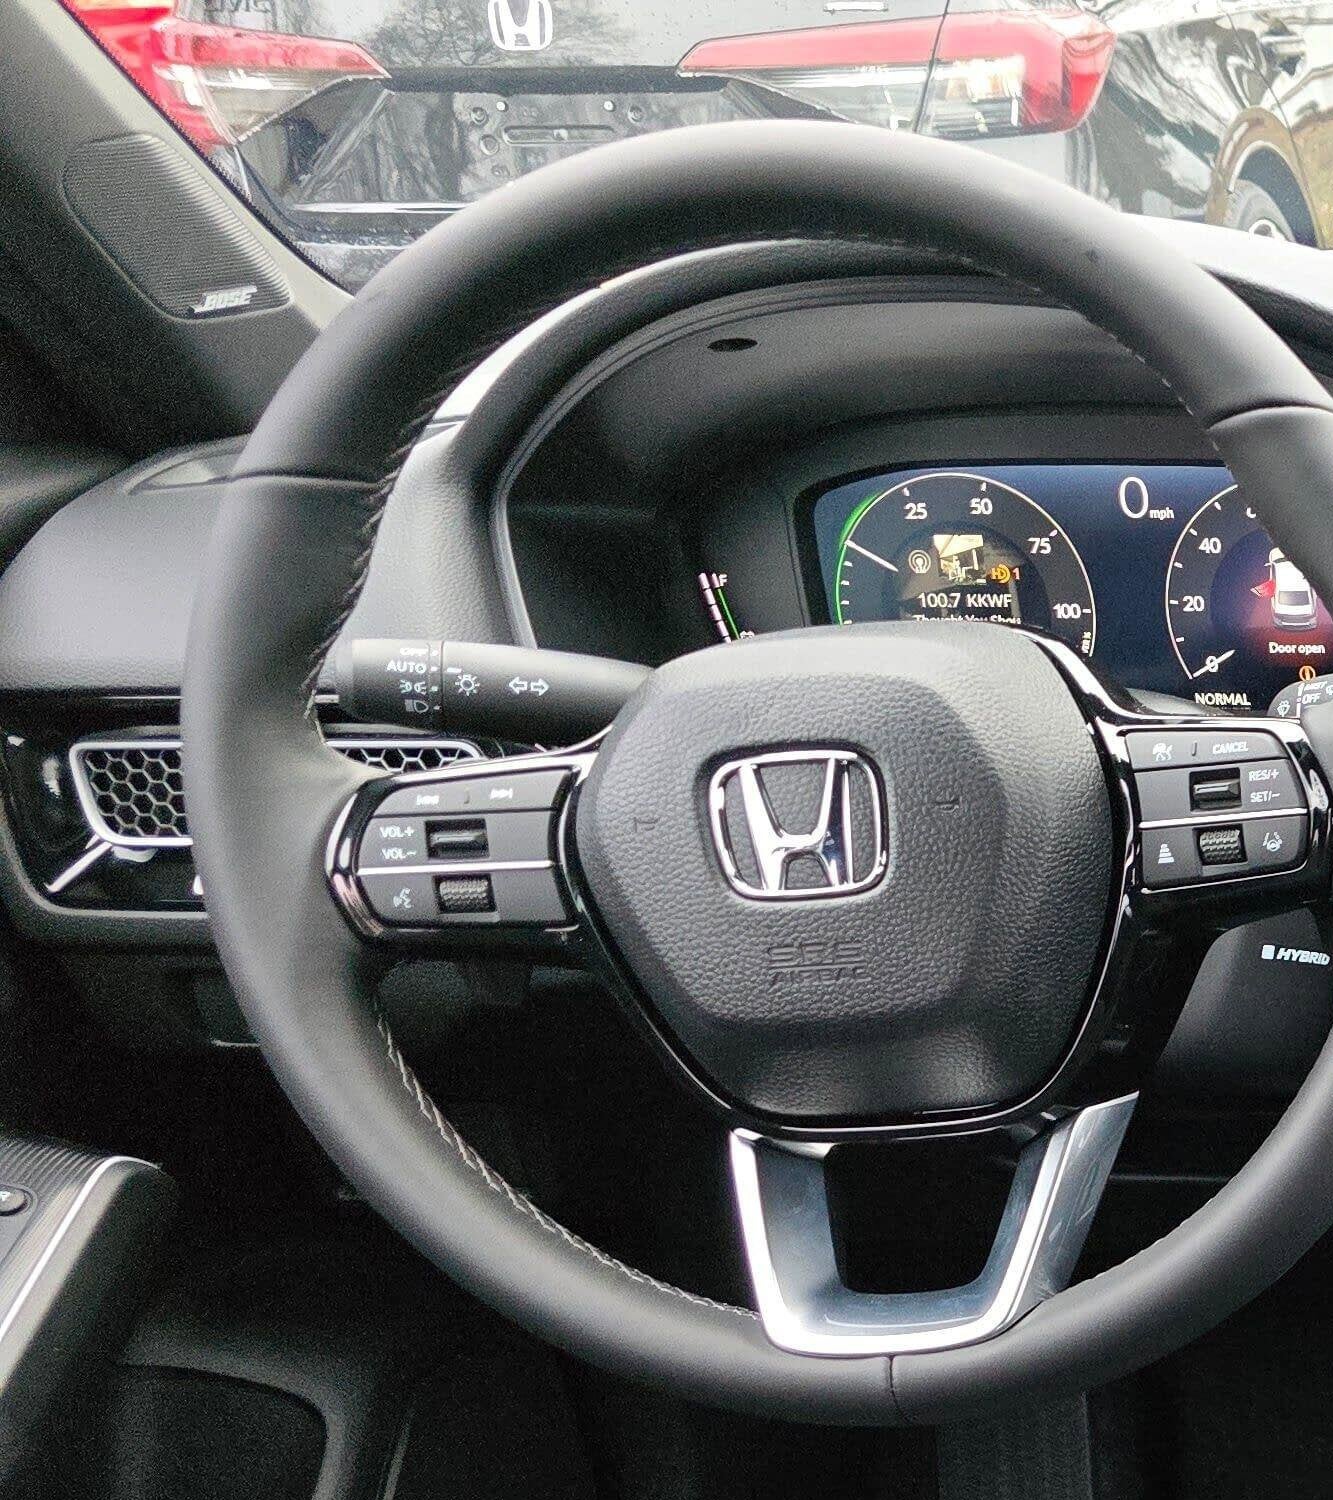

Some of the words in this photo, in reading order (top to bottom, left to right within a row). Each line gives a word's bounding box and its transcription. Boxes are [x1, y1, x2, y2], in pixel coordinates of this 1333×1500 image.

[1118, 476, 1149, 519] 0
[1150, 507, 1175, 520] mph
[904, 503, 928, 519] 25
[970, 498, 993, 515] 50
[1027, 538, 1052, 554] 75
[1198, 538, 1222, 554] 40
[917, 593, 961, 608] 100.7
[966, 593, 1013, 608] KKWF
[1183, 595, 1205, 612] 20
[1053, 603, 1082, 619] 100
[1269, 642, 1296, 654] Door
[1298, 643, 1325, 656] open
[386, 659, 427, 674] AUTO
[1194, 692, 1252, 706] NORMAL
[1302, 692, 1322, 704] OFF
[1212, 741, 1249, 754] CANCEL
[1248, 769, 1280, 781] RES/+
[380, 826, 414, 838] VOL+
[1276, 947, 1331, 966] HYBRID
